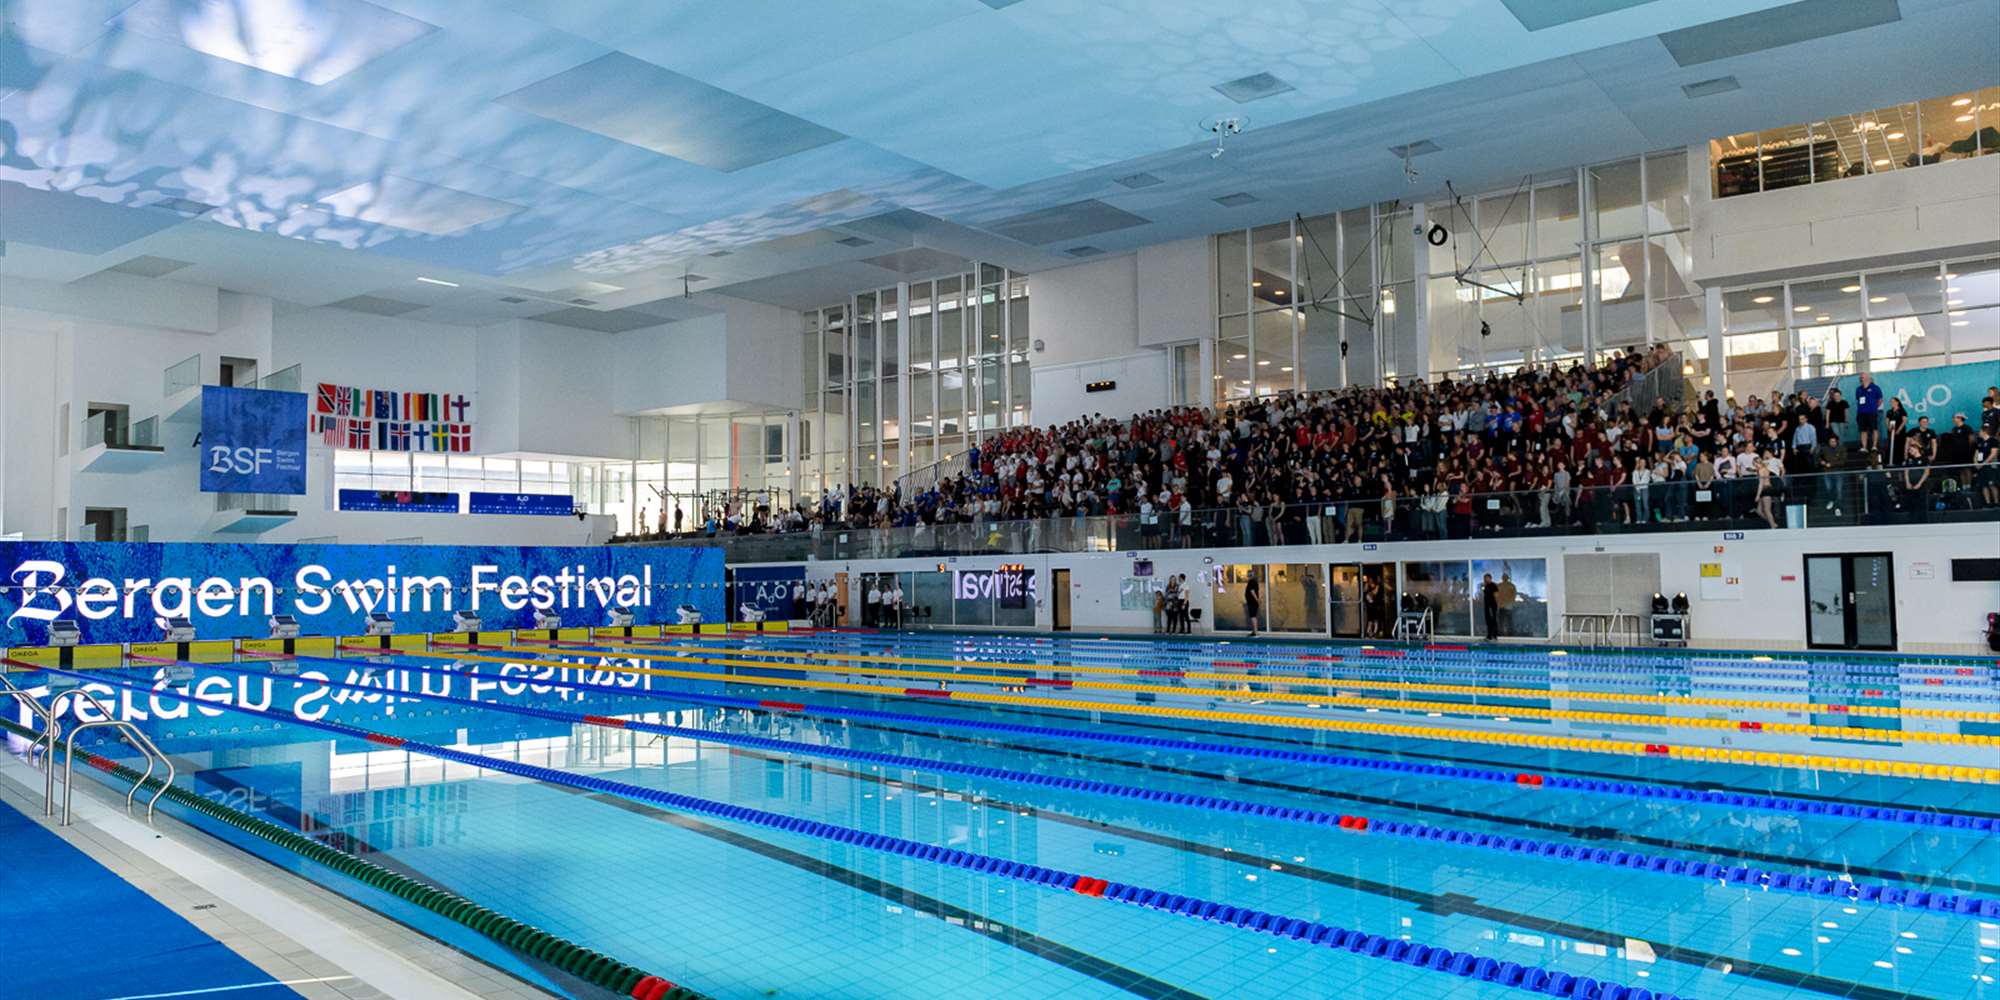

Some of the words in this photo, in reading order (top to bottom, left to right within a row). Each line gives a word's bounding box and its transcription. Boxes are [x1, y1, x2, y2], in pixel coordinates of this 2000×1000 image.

[208, 445, 273, 475] BSF
[7, 560, 273, 629] Bergen
[295, 565, 451, 615] Swim
[472, 565, 651, 610] Festival
